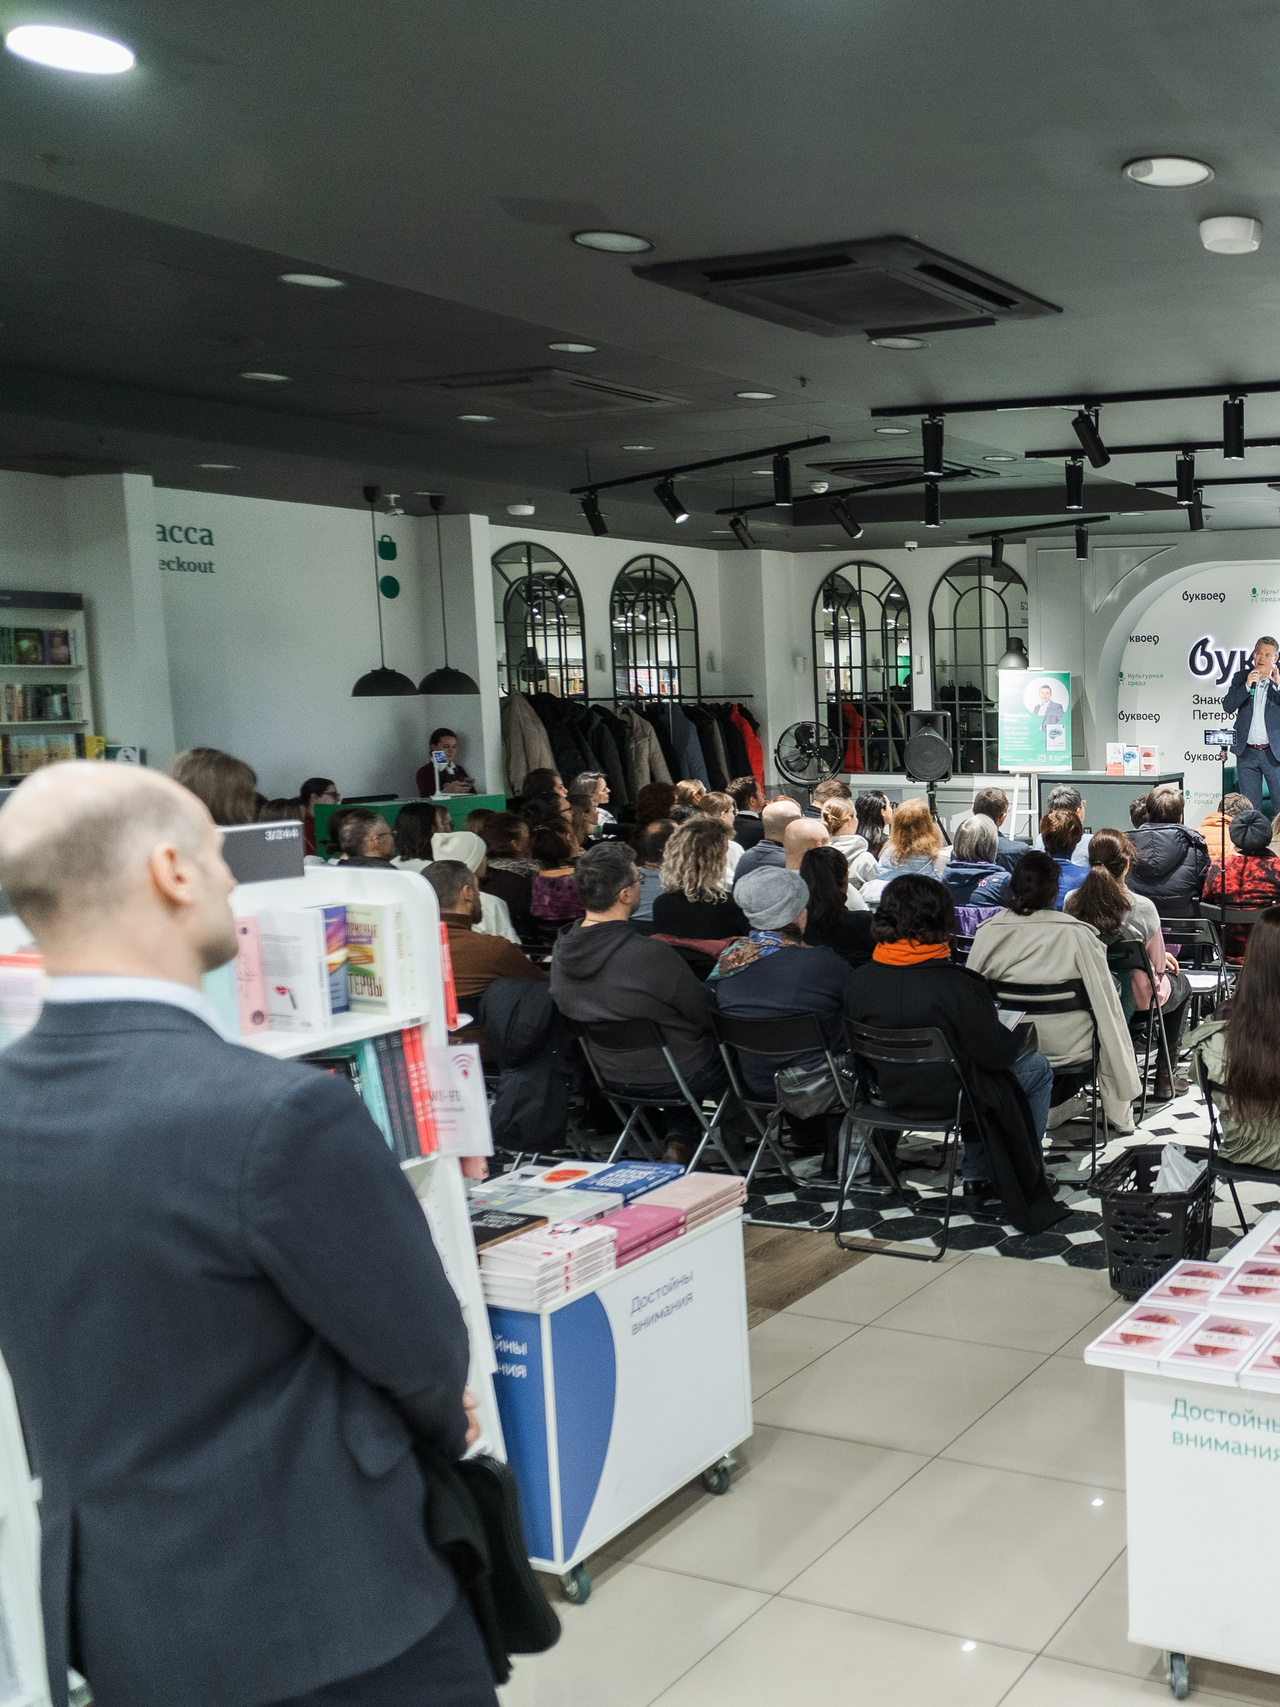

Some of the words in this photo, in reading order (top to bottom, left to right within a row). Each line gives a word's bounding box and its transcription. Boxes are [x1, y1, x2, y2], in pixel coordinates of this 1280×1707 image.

[156, 524, 215, 546] асса
[159, 556, 216, 573] eckout
[1182, 591, 1226, 603] буквоед
[1129, 634, 1160, 645] квоед
[1118, 710, 1161, 723] буквоед
[629, 1269, 694, 1318] Достойны
[631, 1291, 694, 1336] внимания
